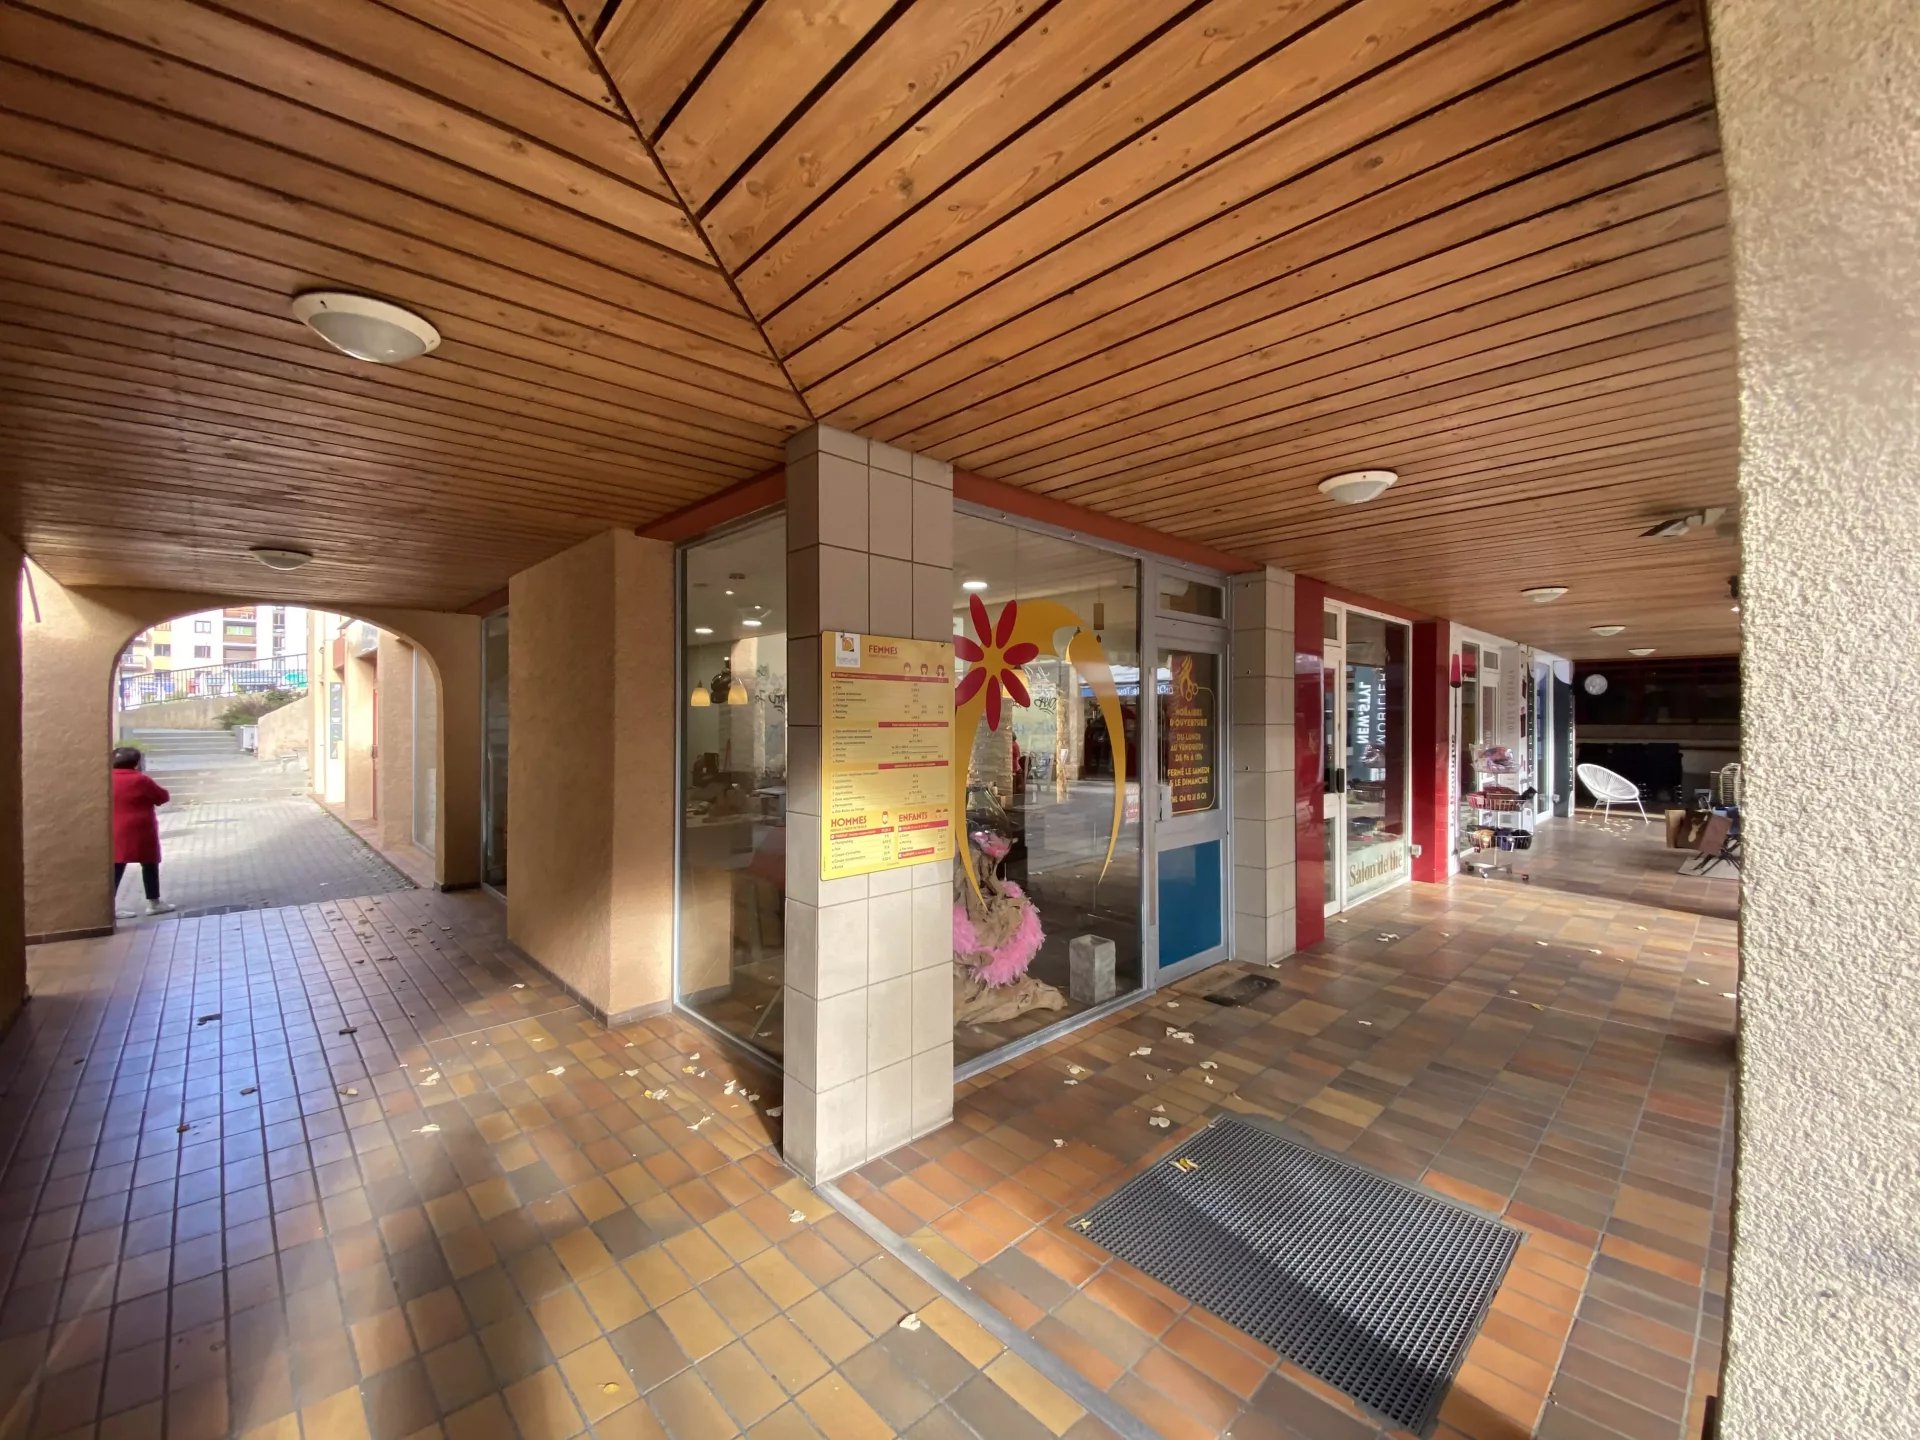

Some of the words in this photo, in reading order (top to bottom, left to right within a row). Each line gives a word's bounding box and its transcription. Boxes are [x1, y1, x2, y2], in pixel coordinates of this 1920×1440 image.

[868, 644, 898, 655] FEMMES
[1185, 767, 1192, 775] LE
[1174, 778, 1182, 787] LE
[1181, 776, 1209, 786] DIMANCHE
[831, 816, 867, 827] HOMMES
[898, 812, 928, 822] ENFANTS
[1349, 861, 1376, 887] Salon
[1377, 853, 1388, 876] de
